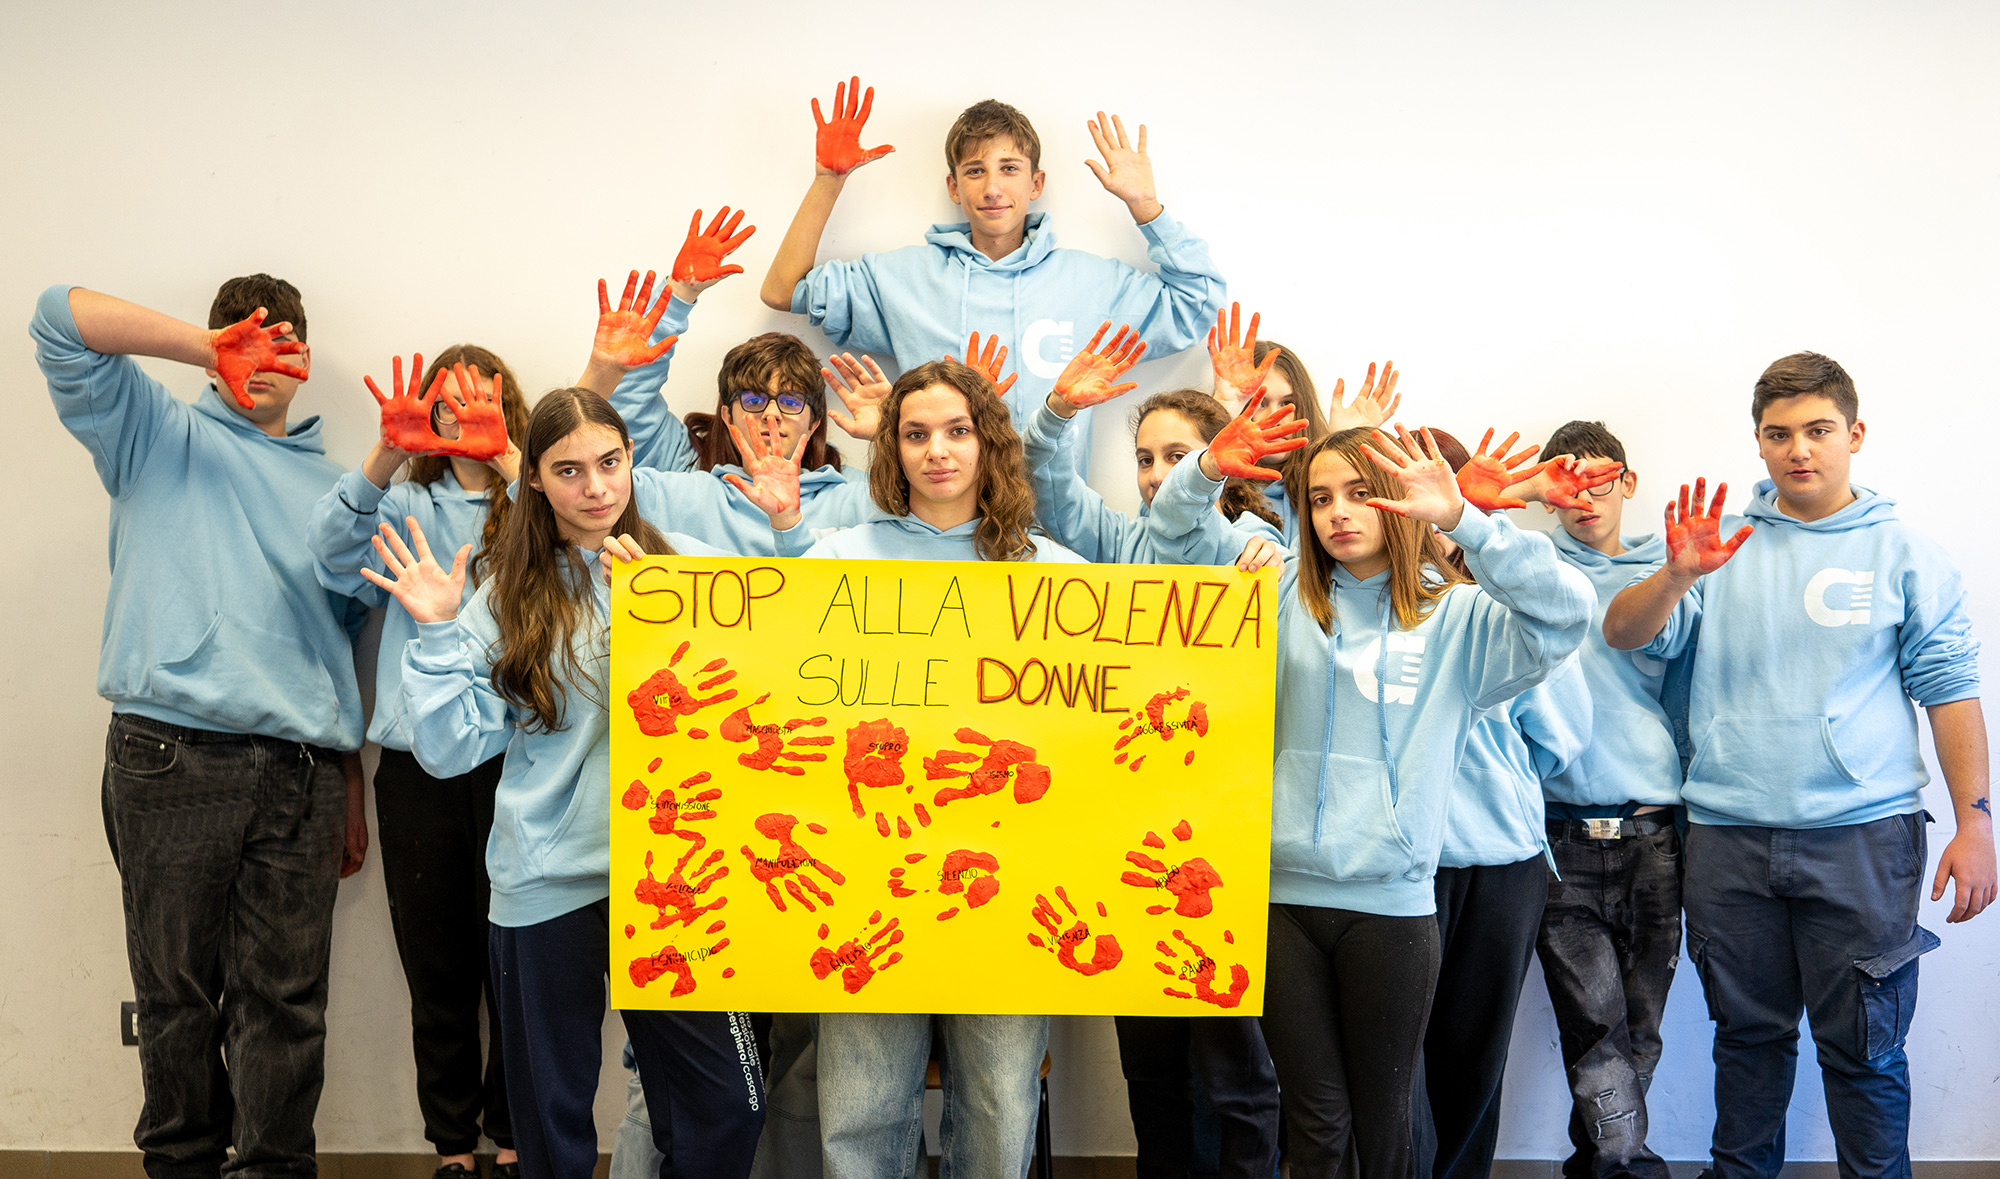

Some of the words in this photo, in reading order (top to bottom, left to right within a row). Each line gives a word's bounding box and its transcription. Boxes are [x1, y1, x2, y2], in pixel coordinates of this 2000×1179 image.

[628, 566, 786, 631] STOP
[818, 573, 971, 637] ALLA
[1007, 574, 1261, 648] VIOLENZA
[797, 654, 949, 707] SULLE
[977, 656, 1131, 713] DONNE
[868, 741, 902, 752] STUPRO
[937, 868, 978, 882] SILENZIO
[1155, 864, 1180, 892] ABUSO
[1181, 956, 1216, 978] PAURA
[737, 1012, 757, 1067] fessionale
